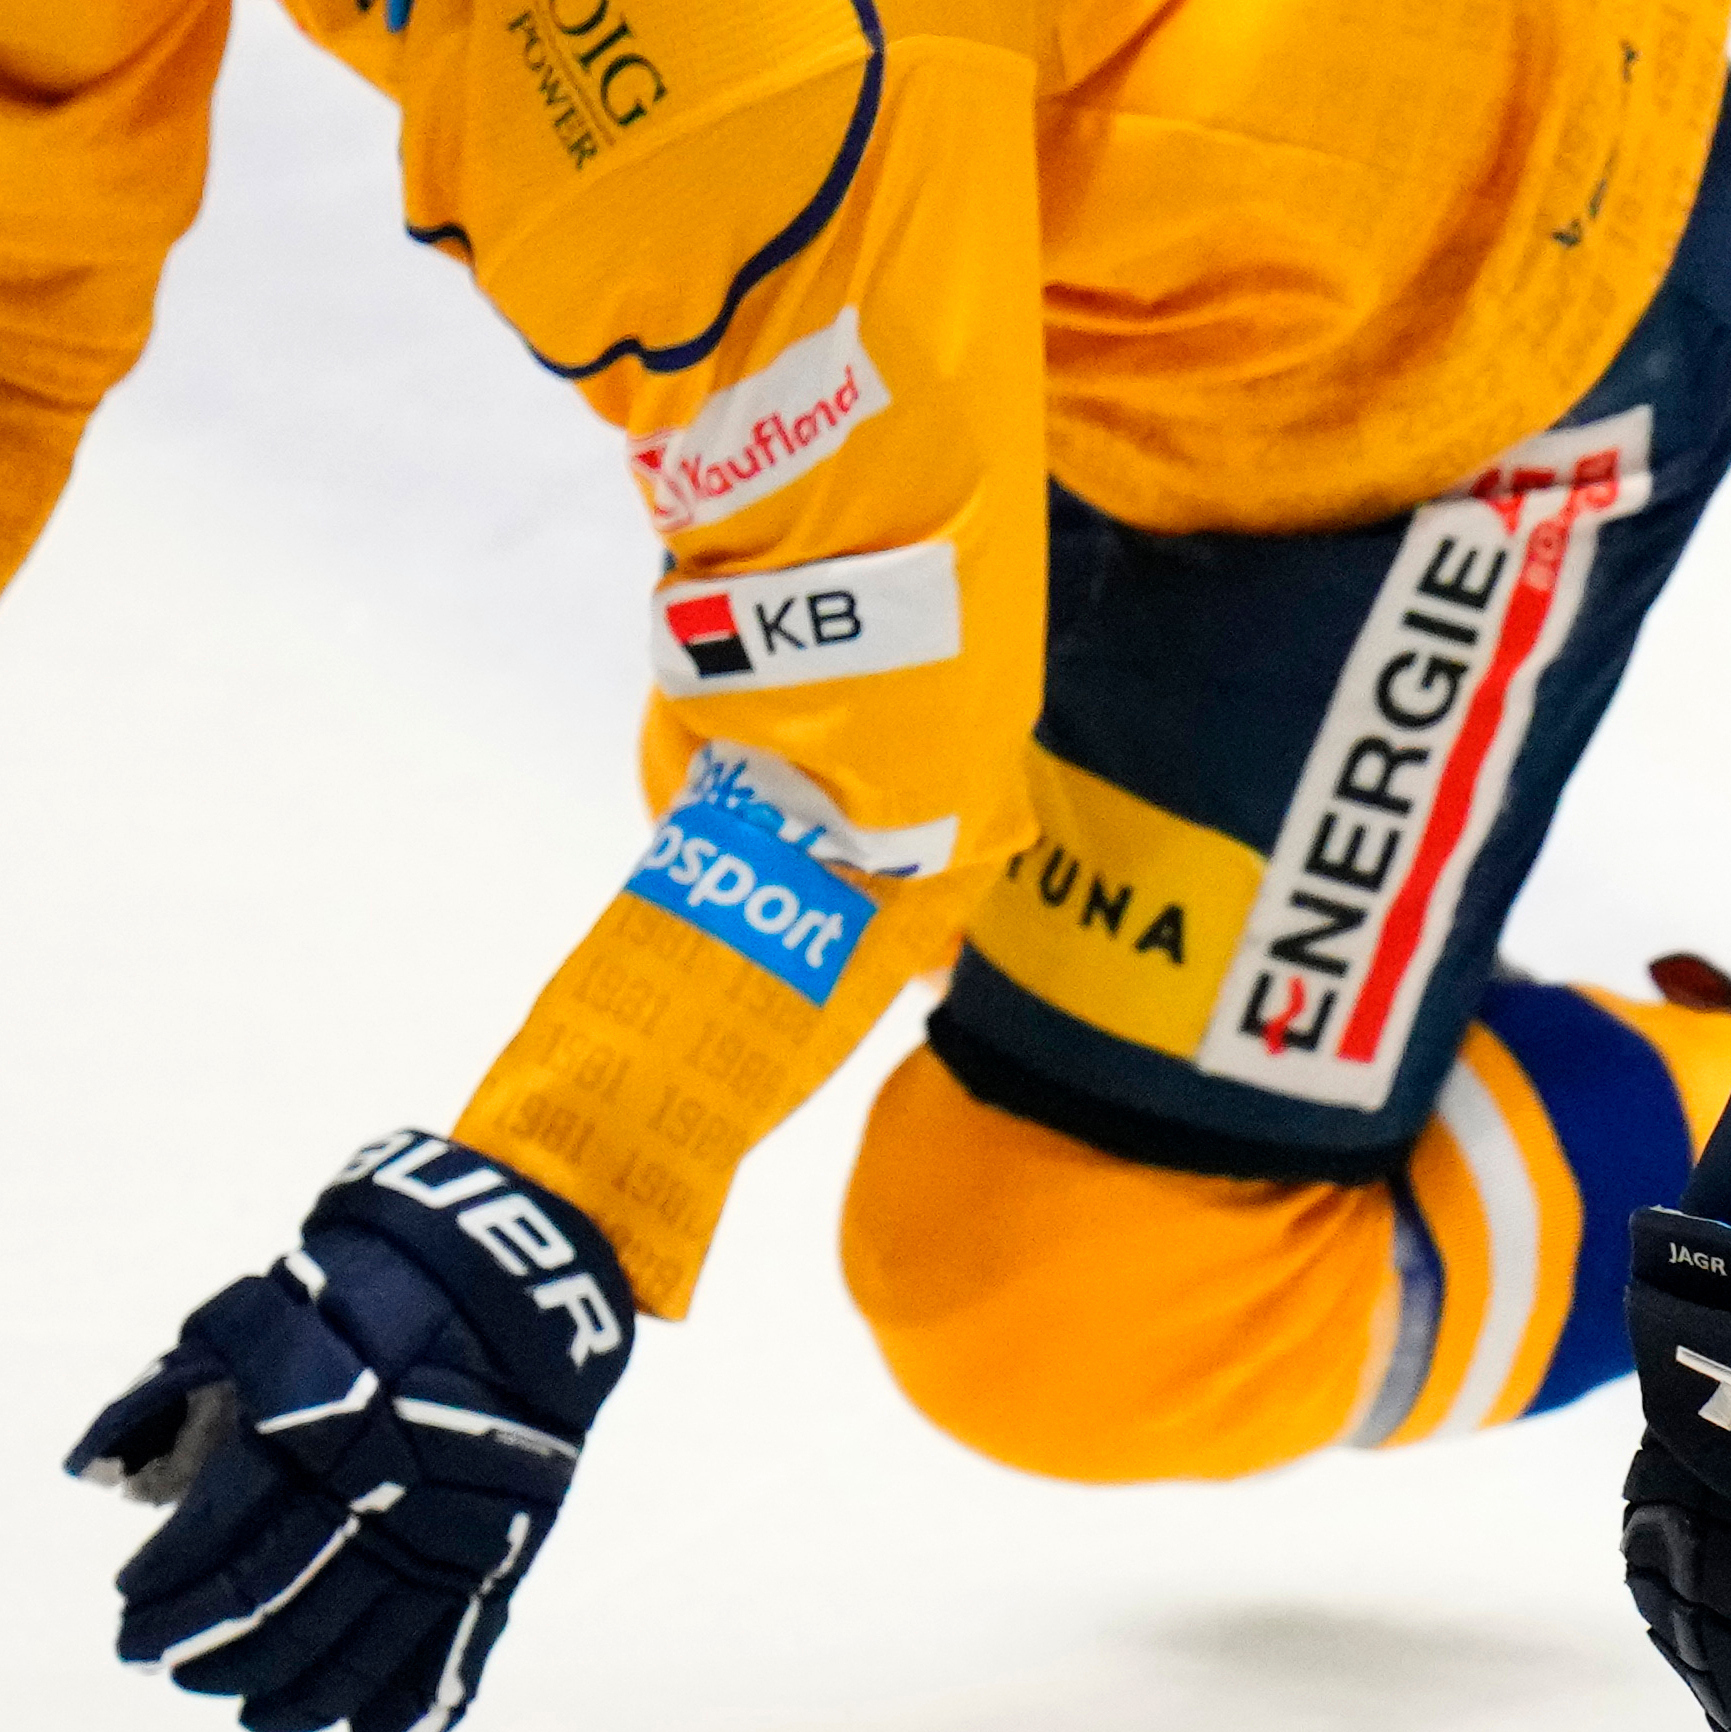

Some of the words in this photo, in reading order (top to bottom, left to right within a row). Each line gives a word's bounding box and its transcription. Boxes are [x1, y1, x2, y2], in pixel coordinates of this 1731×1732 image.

[507, 10, 598, 170] POWER
[755, 590, 863, 655] KB
[1238, 536, 1508, 1054] ENERGIE
[1668, 1242, 1728, 1277] JAGR
